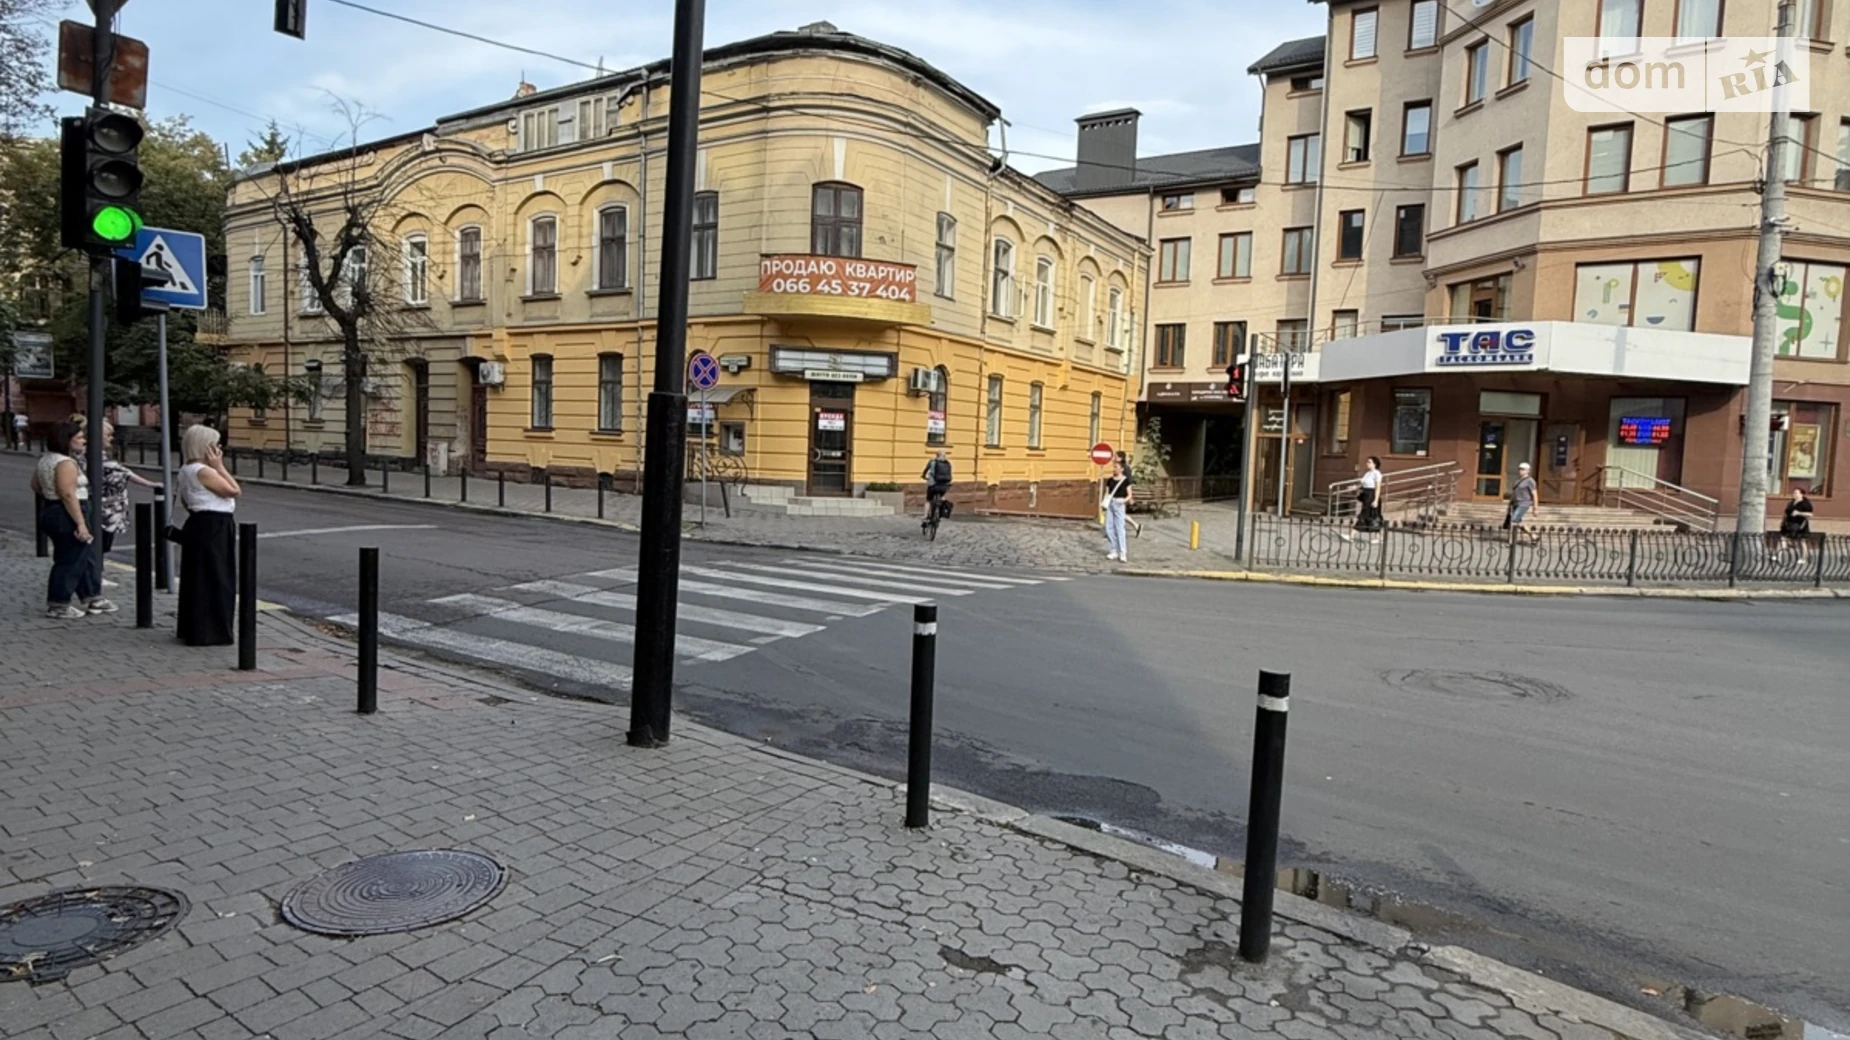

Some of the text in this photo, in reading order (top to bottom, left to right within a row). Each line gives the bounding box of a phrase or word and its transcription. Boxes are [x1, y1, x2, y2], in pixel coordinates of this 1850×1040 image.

[761, 259, 916, 284] ПРОДАЮ КВАРТИР
[772, 278, 911, 302] 066 45 37 404
[1437, 329, 1536, 354] ТАС
